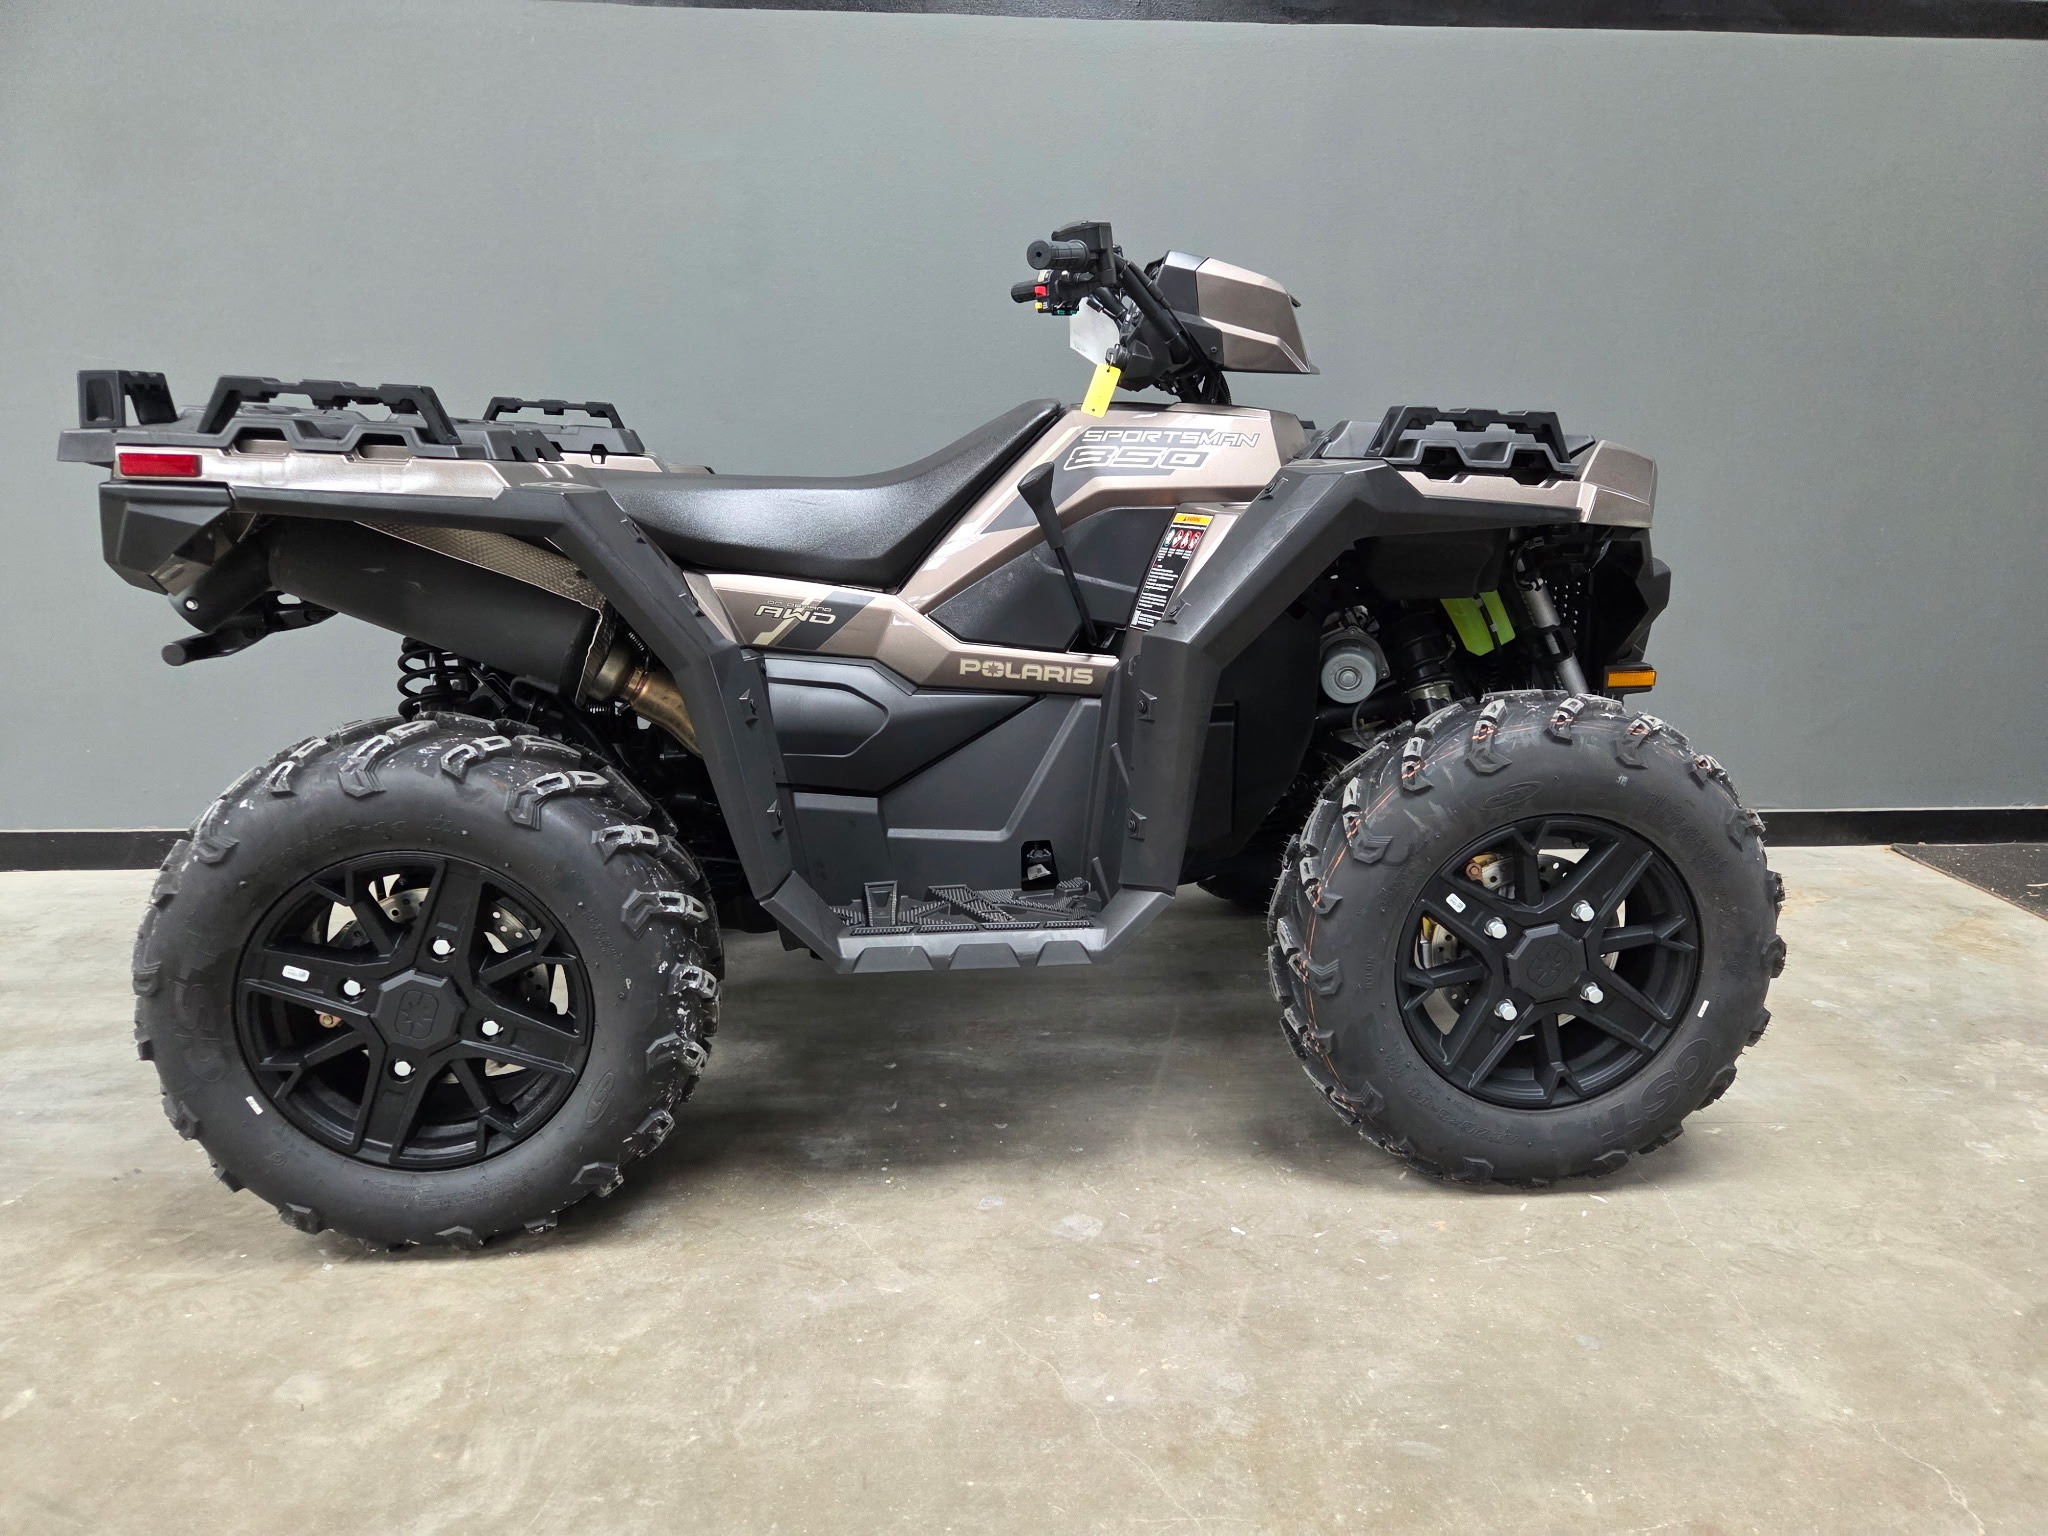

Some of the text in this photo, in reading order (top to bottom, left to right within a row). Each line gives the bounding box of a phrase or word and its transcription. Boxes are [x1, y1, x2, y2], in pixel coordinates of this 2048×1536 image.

[1081, 428, 1261, 449] SPORTSMAN
[1063, 445, 1210, 471] 850
[754, 604, 837, 625] AWD
[959, 657, 1094, 685] POLARIS
[1601, 1037, 1713, 1146] CST
